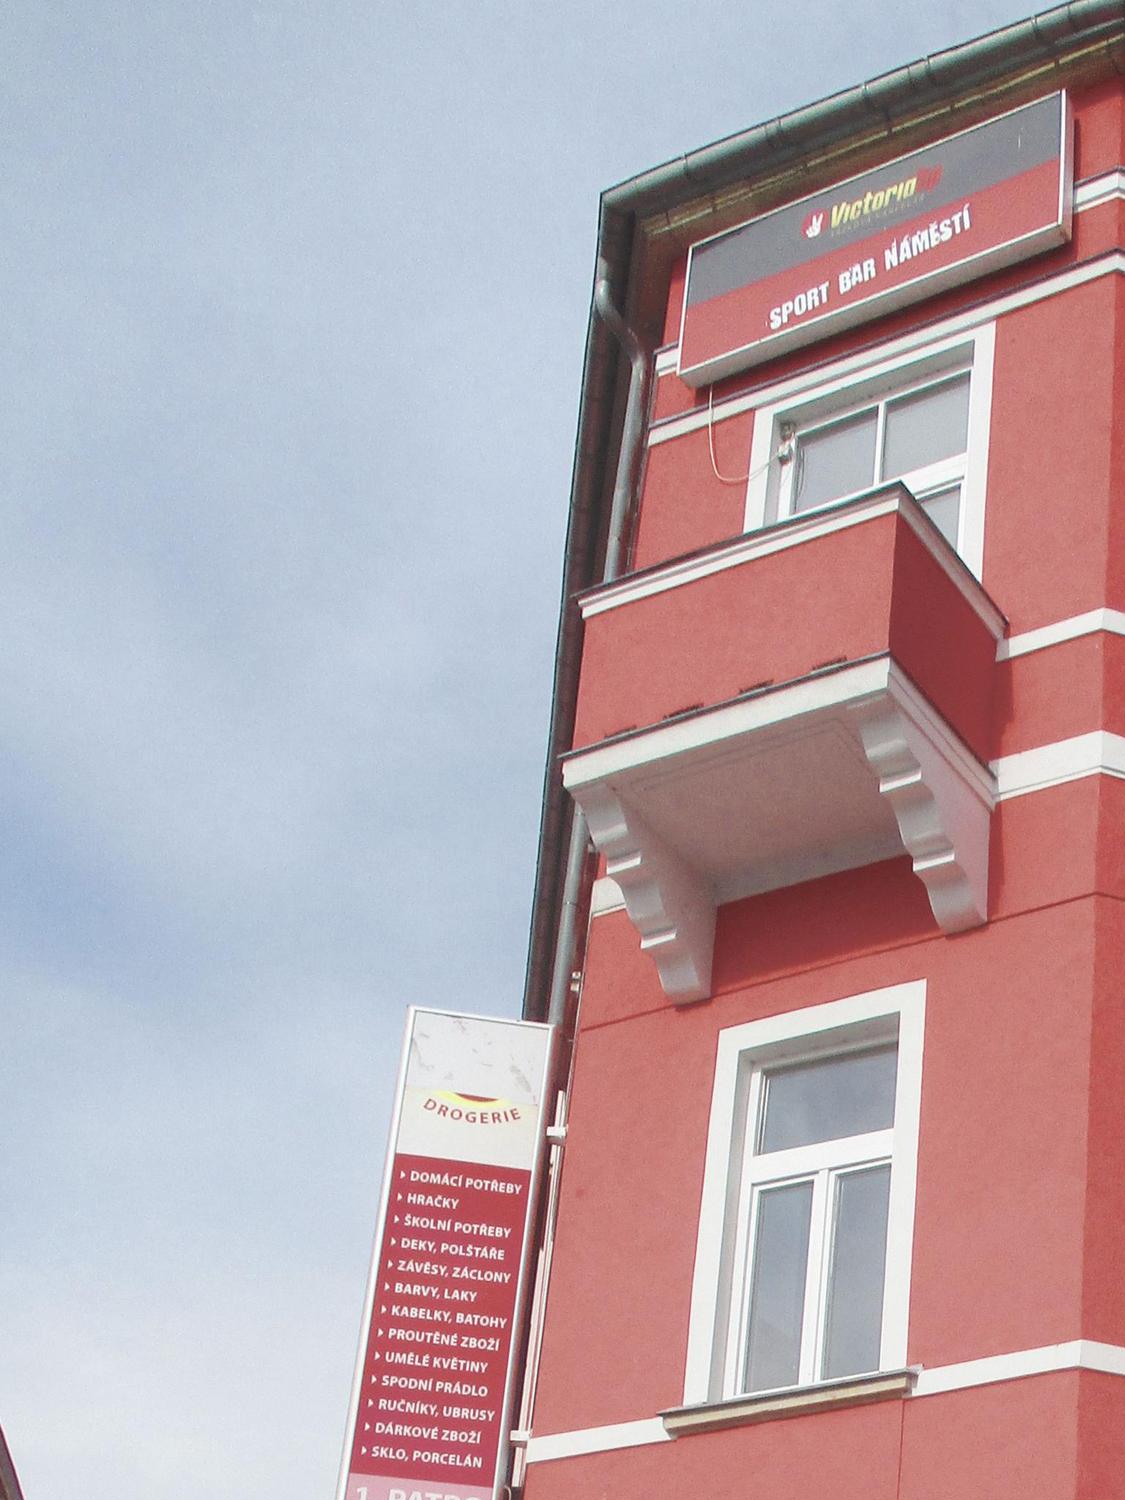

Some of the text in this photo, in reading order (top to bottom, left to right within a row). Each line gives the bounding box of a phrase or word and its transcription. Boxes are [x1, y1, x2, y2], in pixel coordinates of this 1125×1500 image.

[769, 281, 830, 330] SPORT
[838, 258, 876, 293] BAR
[884, 204, 971, 271] NÁMĚSTÍ
[423, 1098, 522, 1124] DROGERIE
[409, 1170, 523, 1195] DOMÁCÍ POTŘEBY
[406, 1192, 460, 1210] HRAČKY
[403, 1213, 512, 1239] ŠKOLNÍ POTŘEBY
[400, 1237, 505, 1261] DEKY, POLŠTÁŘE
[396, 1258, 512, 1284] ZÁVĚSY, ZÁCLONY
[394, 1282, 478, 1303] BARVY, LAKY
[391, 1304, 508, 1329] KABELKY, BATOHY
[387, 1327, 500, 1352] PROUTĚNÉ ZBOŽÍ
[385, 1351, 489, 1374] UMĚLÉ KVĚTINY
[381, 1374, 489, 1398] SPODNÍ PRÁDLO
[378, 1398, 496, 1422] RUČNÍKY, UBRUSY
[374, 1421, 482, 1445] DÁRKOVÉ ZBOŽÍ
[371, 1445, 483, 1469] SKLO, PORCELÁN
